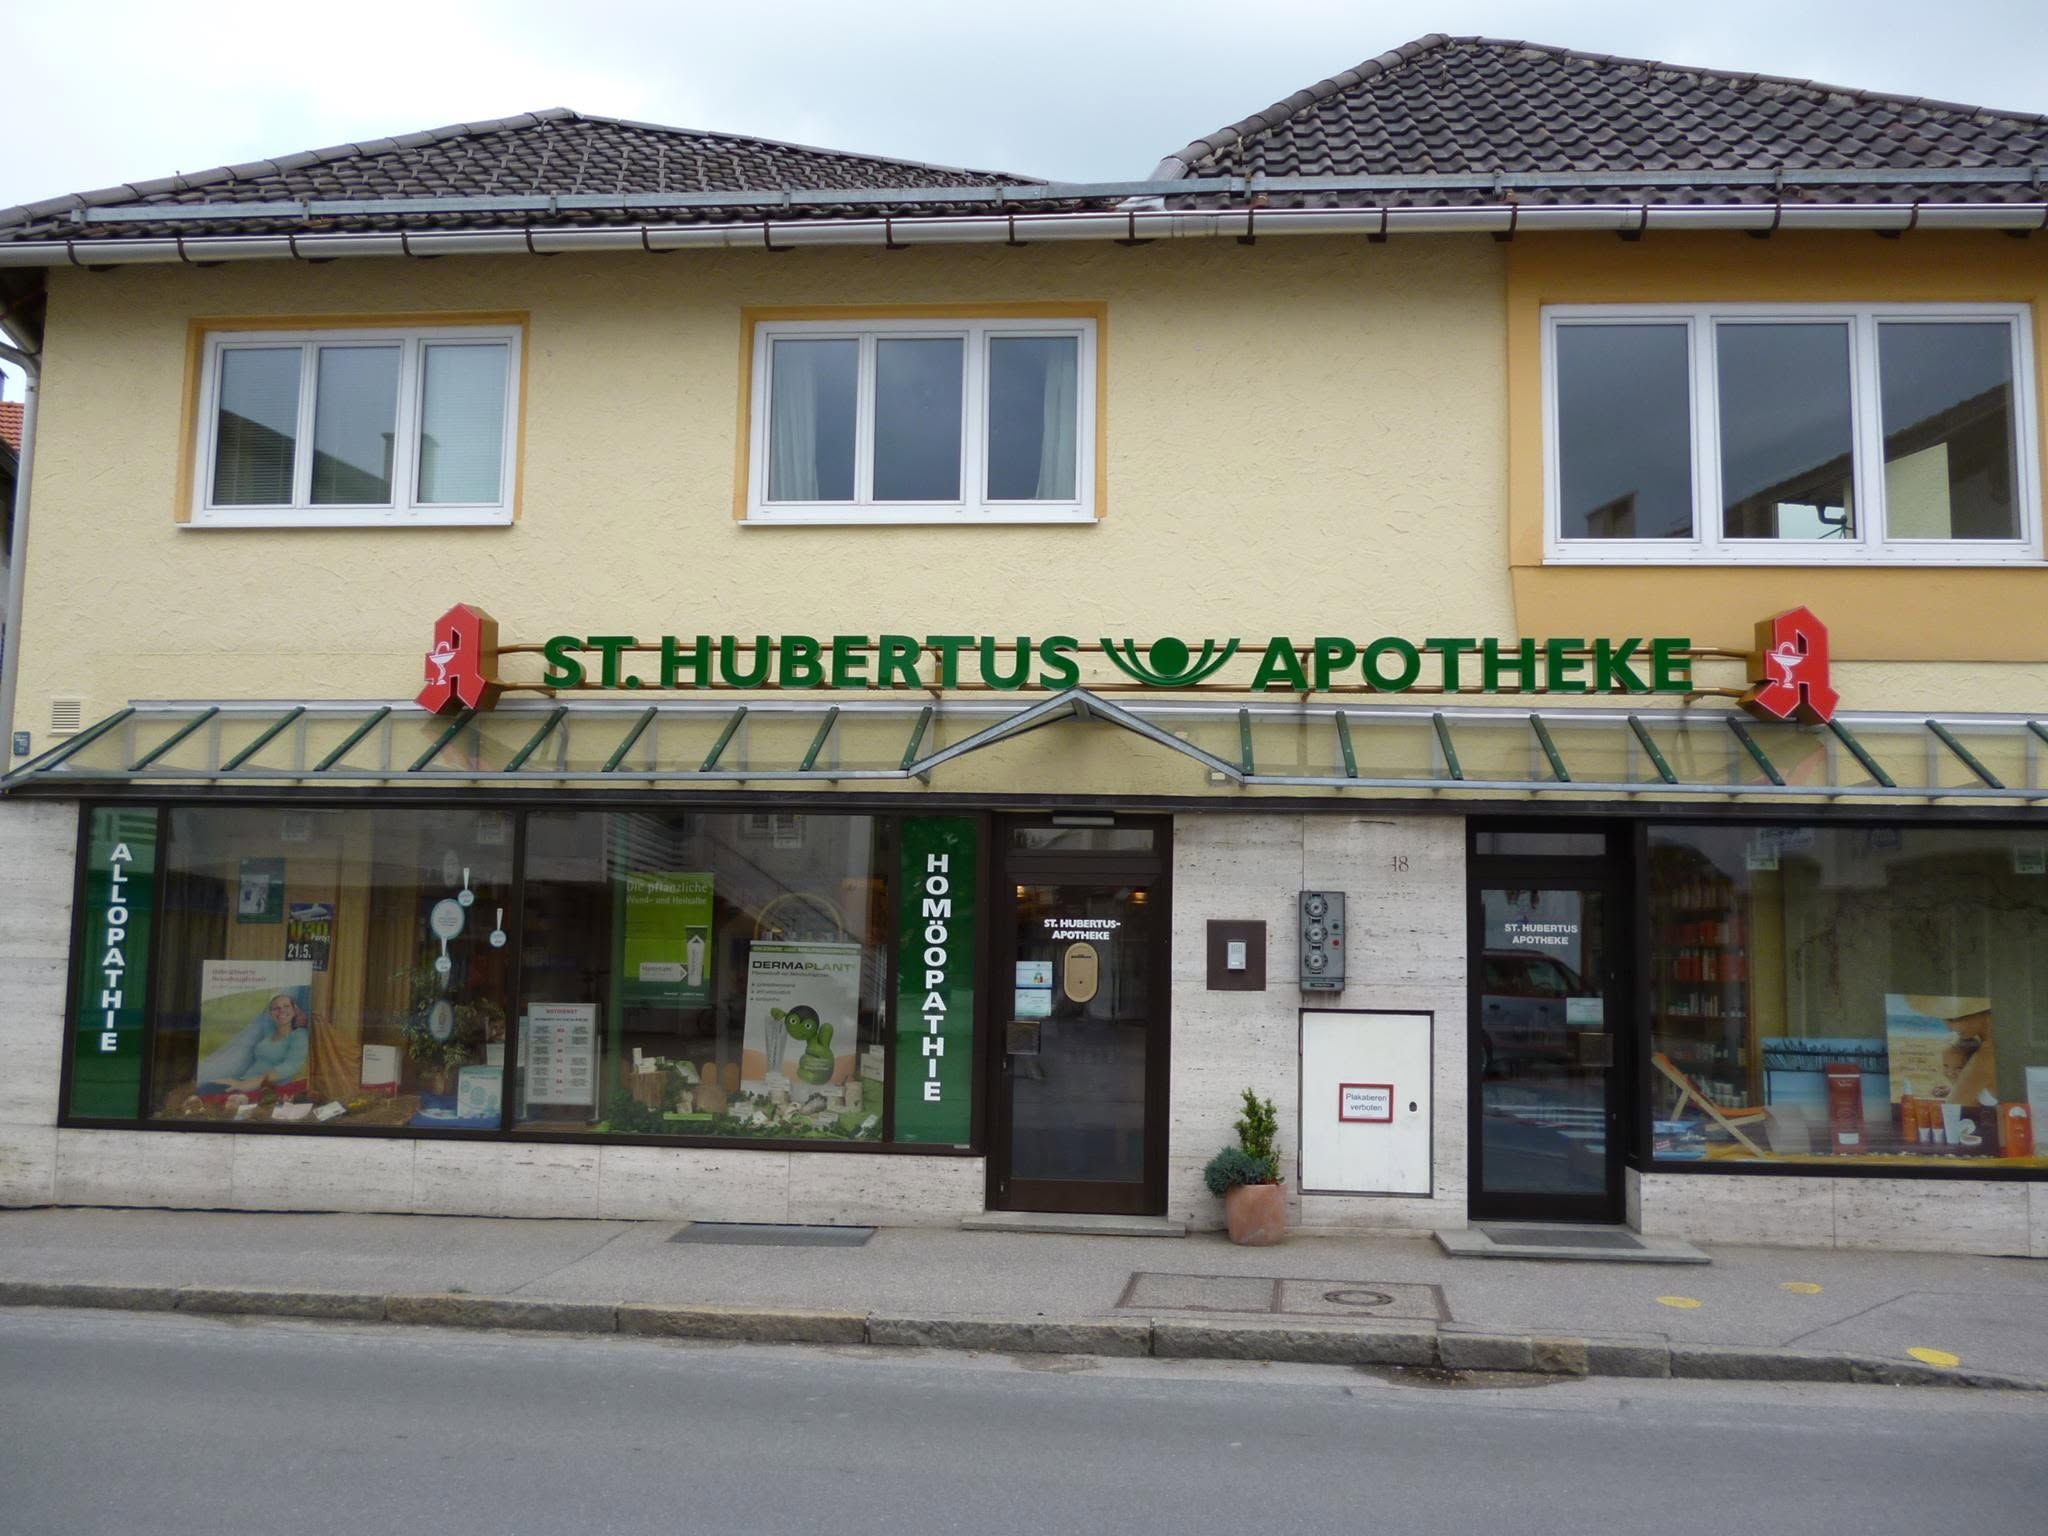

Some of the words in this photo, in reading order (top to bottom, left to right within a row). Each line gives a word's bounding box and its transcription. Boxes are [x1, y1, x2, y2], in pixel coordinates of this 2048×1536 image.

[543, 635, 639, 690] ST.
[660, 634, 1081, 691] HUBERTUS
[1251, 637, 1694, 693] APOTHEKE
[1392, 855, 1409, 872] 18
[647, 880, 708, 894] pflanzliche
[1044, 919, 1058, 928] ST.
[1060, 919, 1121, 929] HUBERTUS-
[1505, 923, 1520, 932] ST.
[1522, 923, 1578, 933] HUBERTUS
[1052, 930, 1110, 940] APOTHEKE
[1512, 936, 1569, 945] APOTHEKE
[99, 843, 132, 1052] ALLOPATHIE
[921, 853, 951, 1102] HOMÖOPATHIE
[1345, 1093, 1387, 1102] Plakatieren
